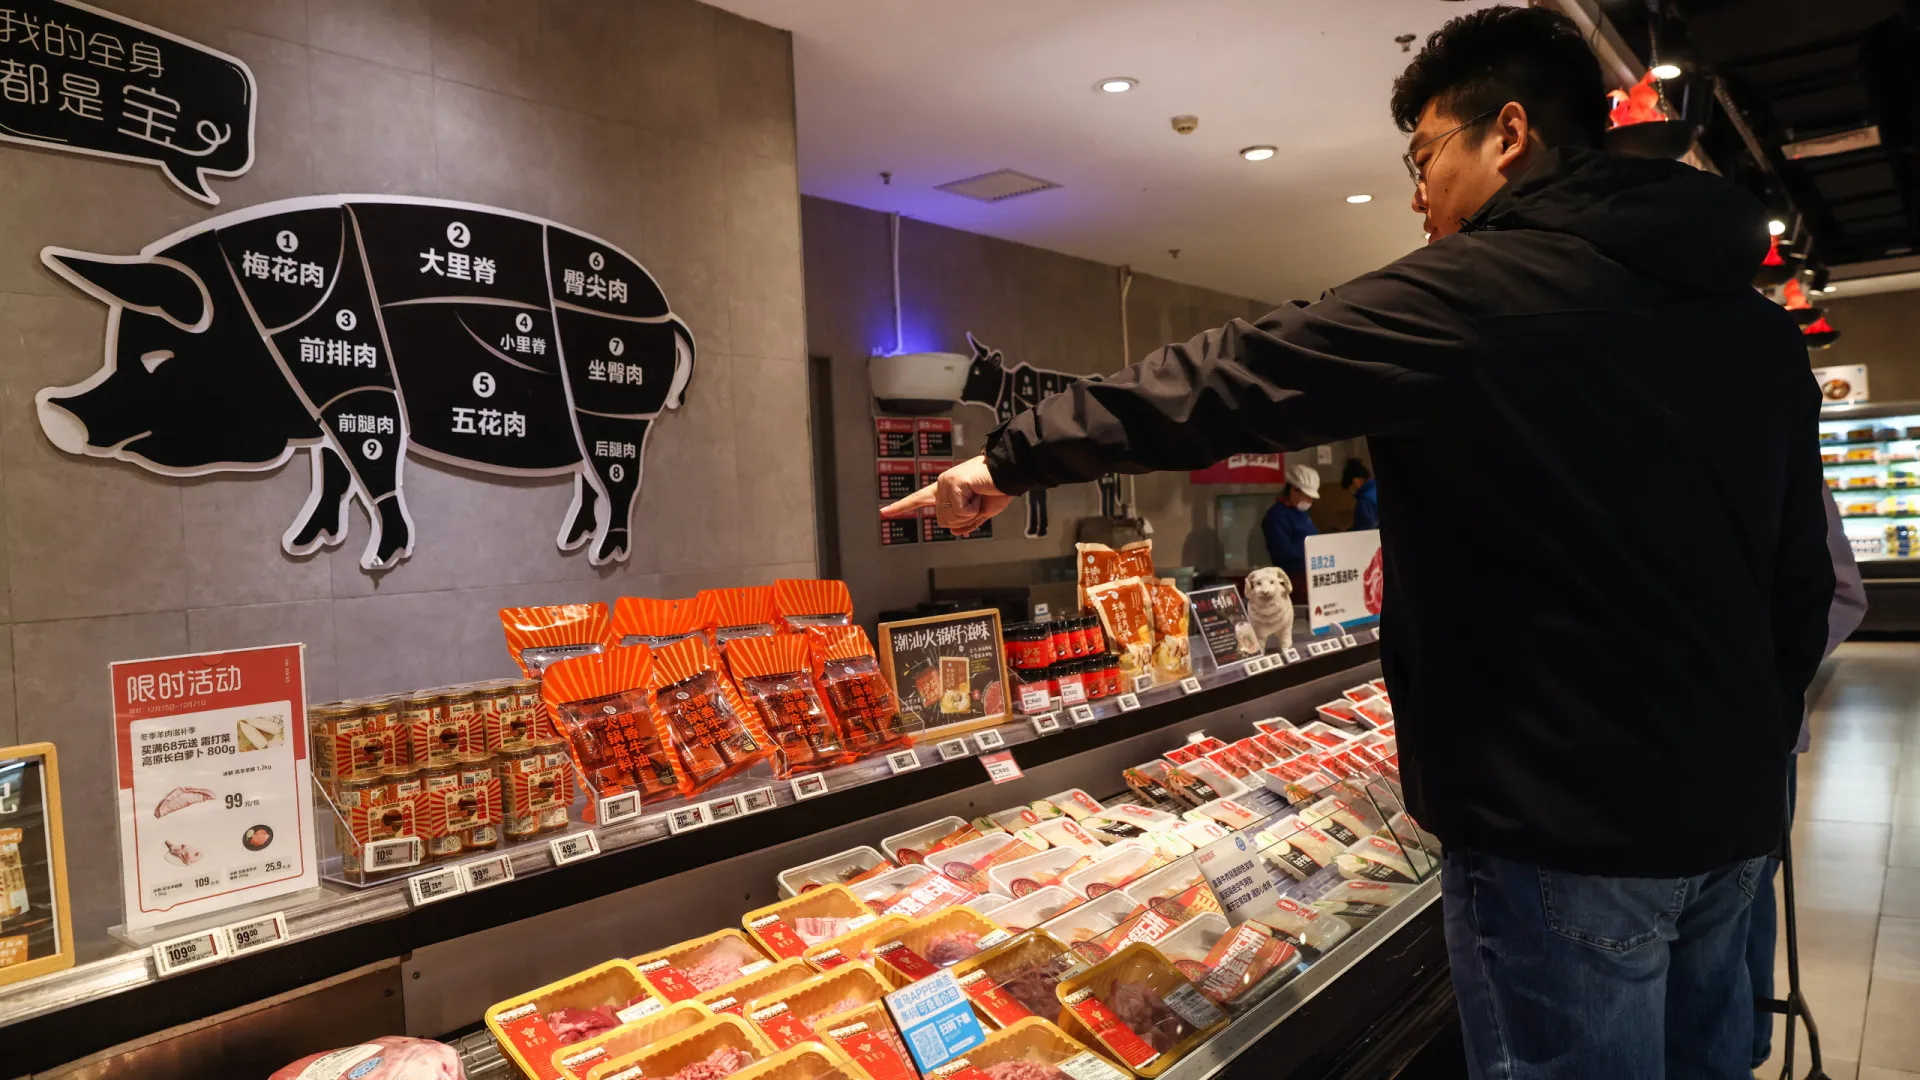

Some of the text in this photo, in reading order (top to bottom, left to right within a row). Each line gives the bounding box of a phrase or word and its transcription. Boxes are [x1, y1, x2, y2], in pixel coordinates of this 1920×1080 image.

[0, 9, 164, 78] 我的全身
[0, 58, 182, 150] 都是宝
[242, 251, 325, 288] 梅花肉
[420, 248, 497, 285] 大里脊
[563, 269, 628, 304] 臀尖肉
[299, 336, 377, 369] 前排肉
[500, 334, 547, 355] 小里脊
[588, 360, 643, 386] 坐臀肉
[338, 413, 394, 435] 前腿肉
[451, 407, 526, 438] 五花肉
[594, 440, 636, 459] 后腿肉
[893, 621, 991, 652] 潮汕火锅好滋味
[127, 665, 242, 704] 限时活动
[850, 679, 871, 721] 火锅底料
[681, 701, 717, 748] 火锅底料
[781, 691, 809, 737] 火锅底料
[140, 726, 196, 741] 冬季羊肉滋补季
[141, 733, 231, 756] 买满68元送 霜打菜
[604, 716, 634, 772] 火锅底料
[617, 712, 652, 768] 醇香牛油
[141, 744, 236, 767] 高原长白萝卜 800g
[225, 792, 243, 810] 99
[194, 876, 210, 889] 109
[265, 861, 282, 873] 25.9
